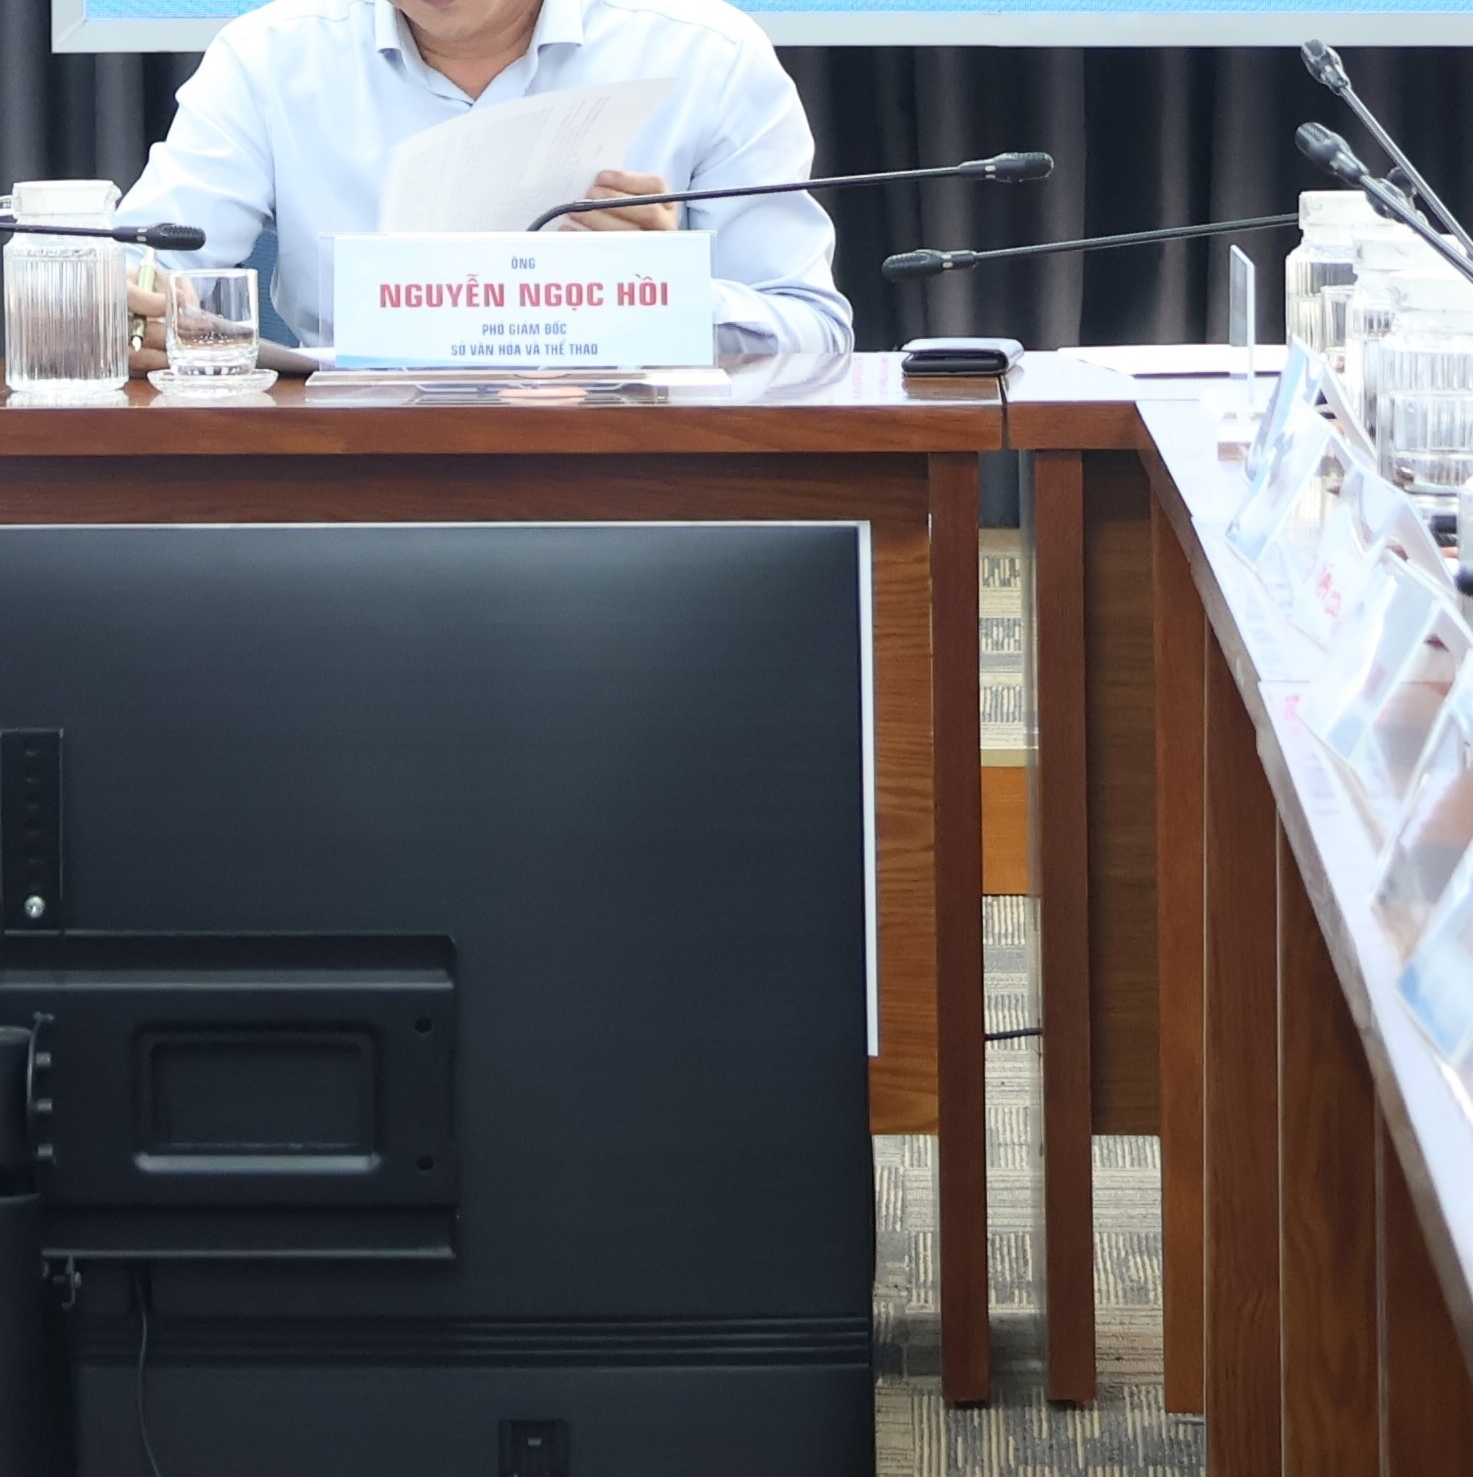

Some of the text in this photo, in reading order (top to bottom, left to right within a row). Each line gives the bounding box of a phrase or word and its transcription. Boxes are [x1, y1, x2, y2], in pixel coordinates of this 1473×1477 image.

[510, 255, 536, 270] ÔNG
[379, 273, 669, 311] NGUYỄN NGỌC HỒI
[568, 342, 599, 356] THAO
